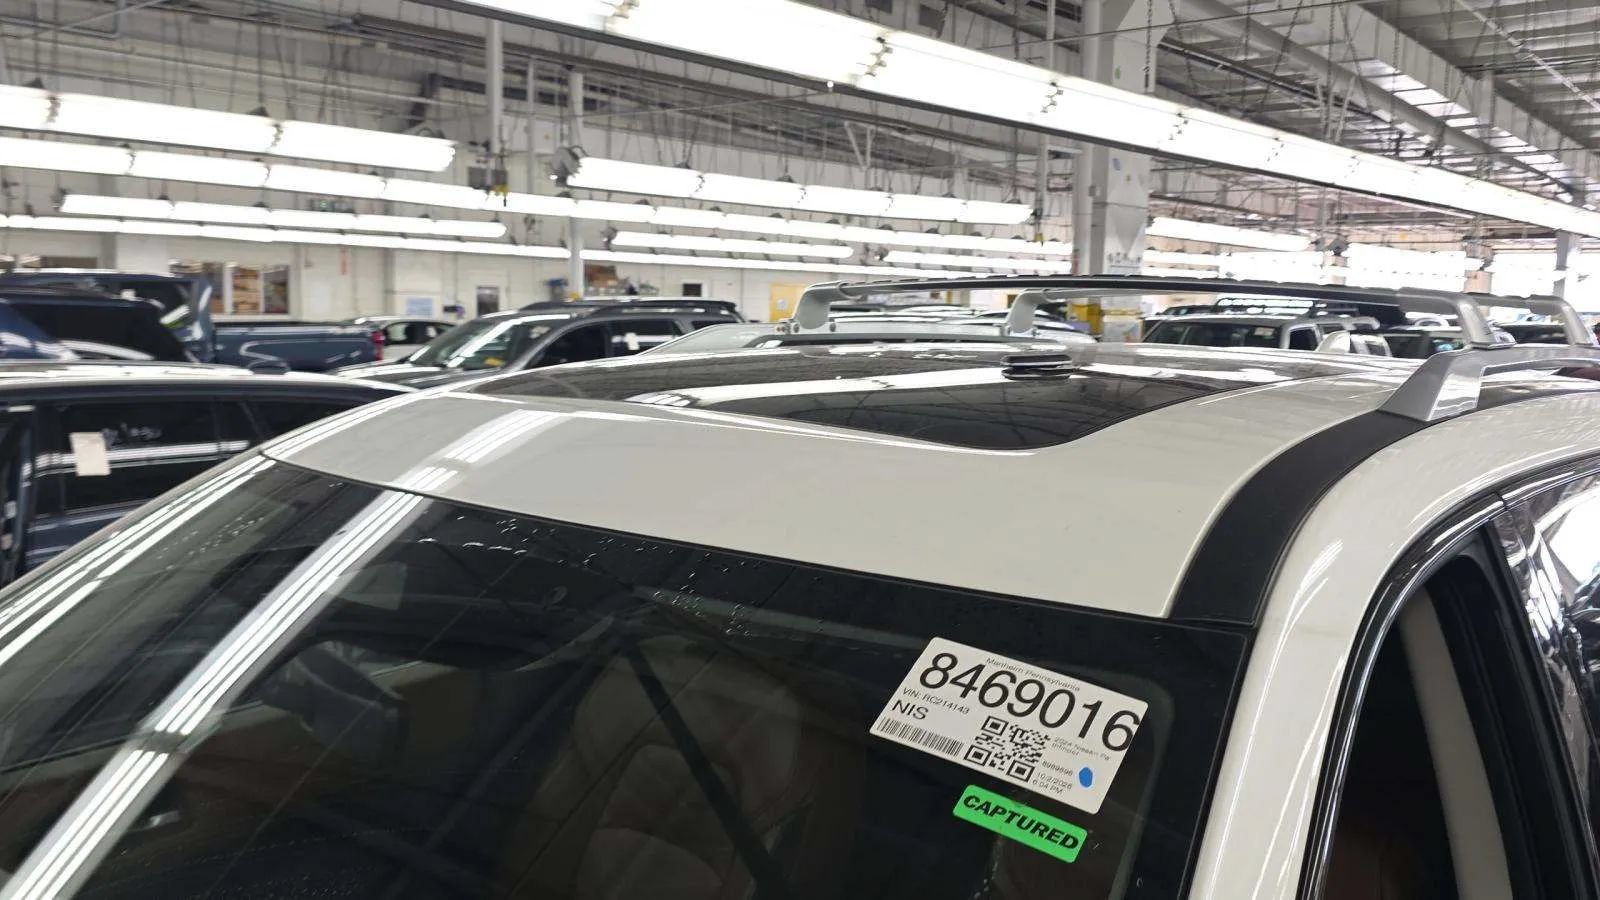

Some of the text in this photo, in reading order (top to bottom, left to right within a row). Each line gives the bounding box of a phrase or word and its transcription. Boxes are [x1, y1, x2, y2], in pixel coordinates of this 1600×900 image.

[892, 699, 929, 720] NIS
[902, 687, 922, 699] VIN:
[919, 652, 1140, 752] 8469016
[963, 794, 1080, 851] CAPTURED
